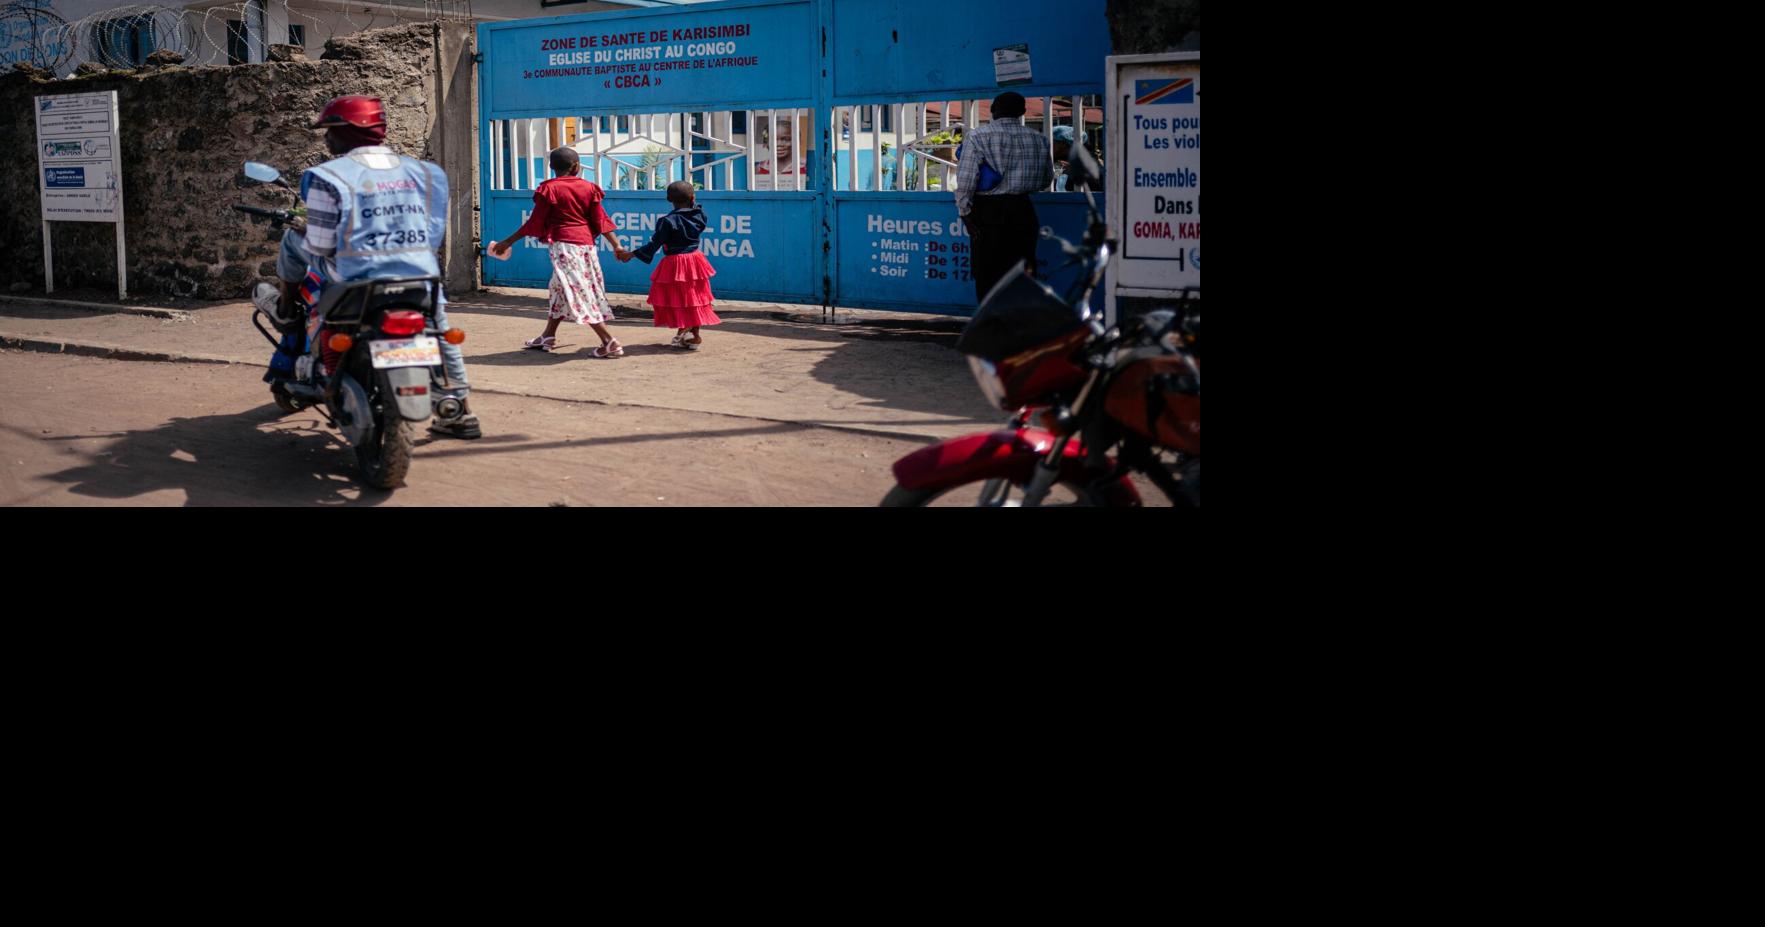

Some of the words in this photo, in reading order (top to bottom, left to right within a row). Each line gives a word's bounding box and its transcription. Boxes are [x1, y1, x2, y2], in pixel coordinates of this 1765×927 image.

[541, 38, 576, 51] ZONE
[580, 36, 597, 48] DE
[602, 32, 645, 46] SANTE
[650, 30, 667, 43] DE
[672, 24, 750, 41] KARISIMBI
[549, 51, 591, 66] EGLISE
[594, 50, 611, 63] DU
[615, 46, 661, 61] CHRIST
[665, 44, 683, 58] AU
[687, 41, 736, 56] CONGO
[523, 71, 533, 79] 3e
[534, 66, 592, 78] COMMUNAUTE
[595, 64, 636, 75] BAPTISTE
[639, 62, 651, 72] AU
[654, 60, 690, 71] CENTRE
[693, 59, 705, 69] DE
[708, 56, 758, 68] L'AFRIQUE
[615, 75, 650, 89] CBCA
[1133, 115, 1167, 130] Tous
[1144, 134, 1169, 149] Les
[1134, 167, 1197, 188] Ensemble
[1154, 195, 1193, 215] Dans
[720, 215, 751, 234] DE
[867, 214, 943, 235] Heures
[1133, 221, 1175, 241] GOMA,
[880, 239, 919, 251] Matin
[880, 252, 909, 264] Midi
[880, 265, 908, 277] Soir
